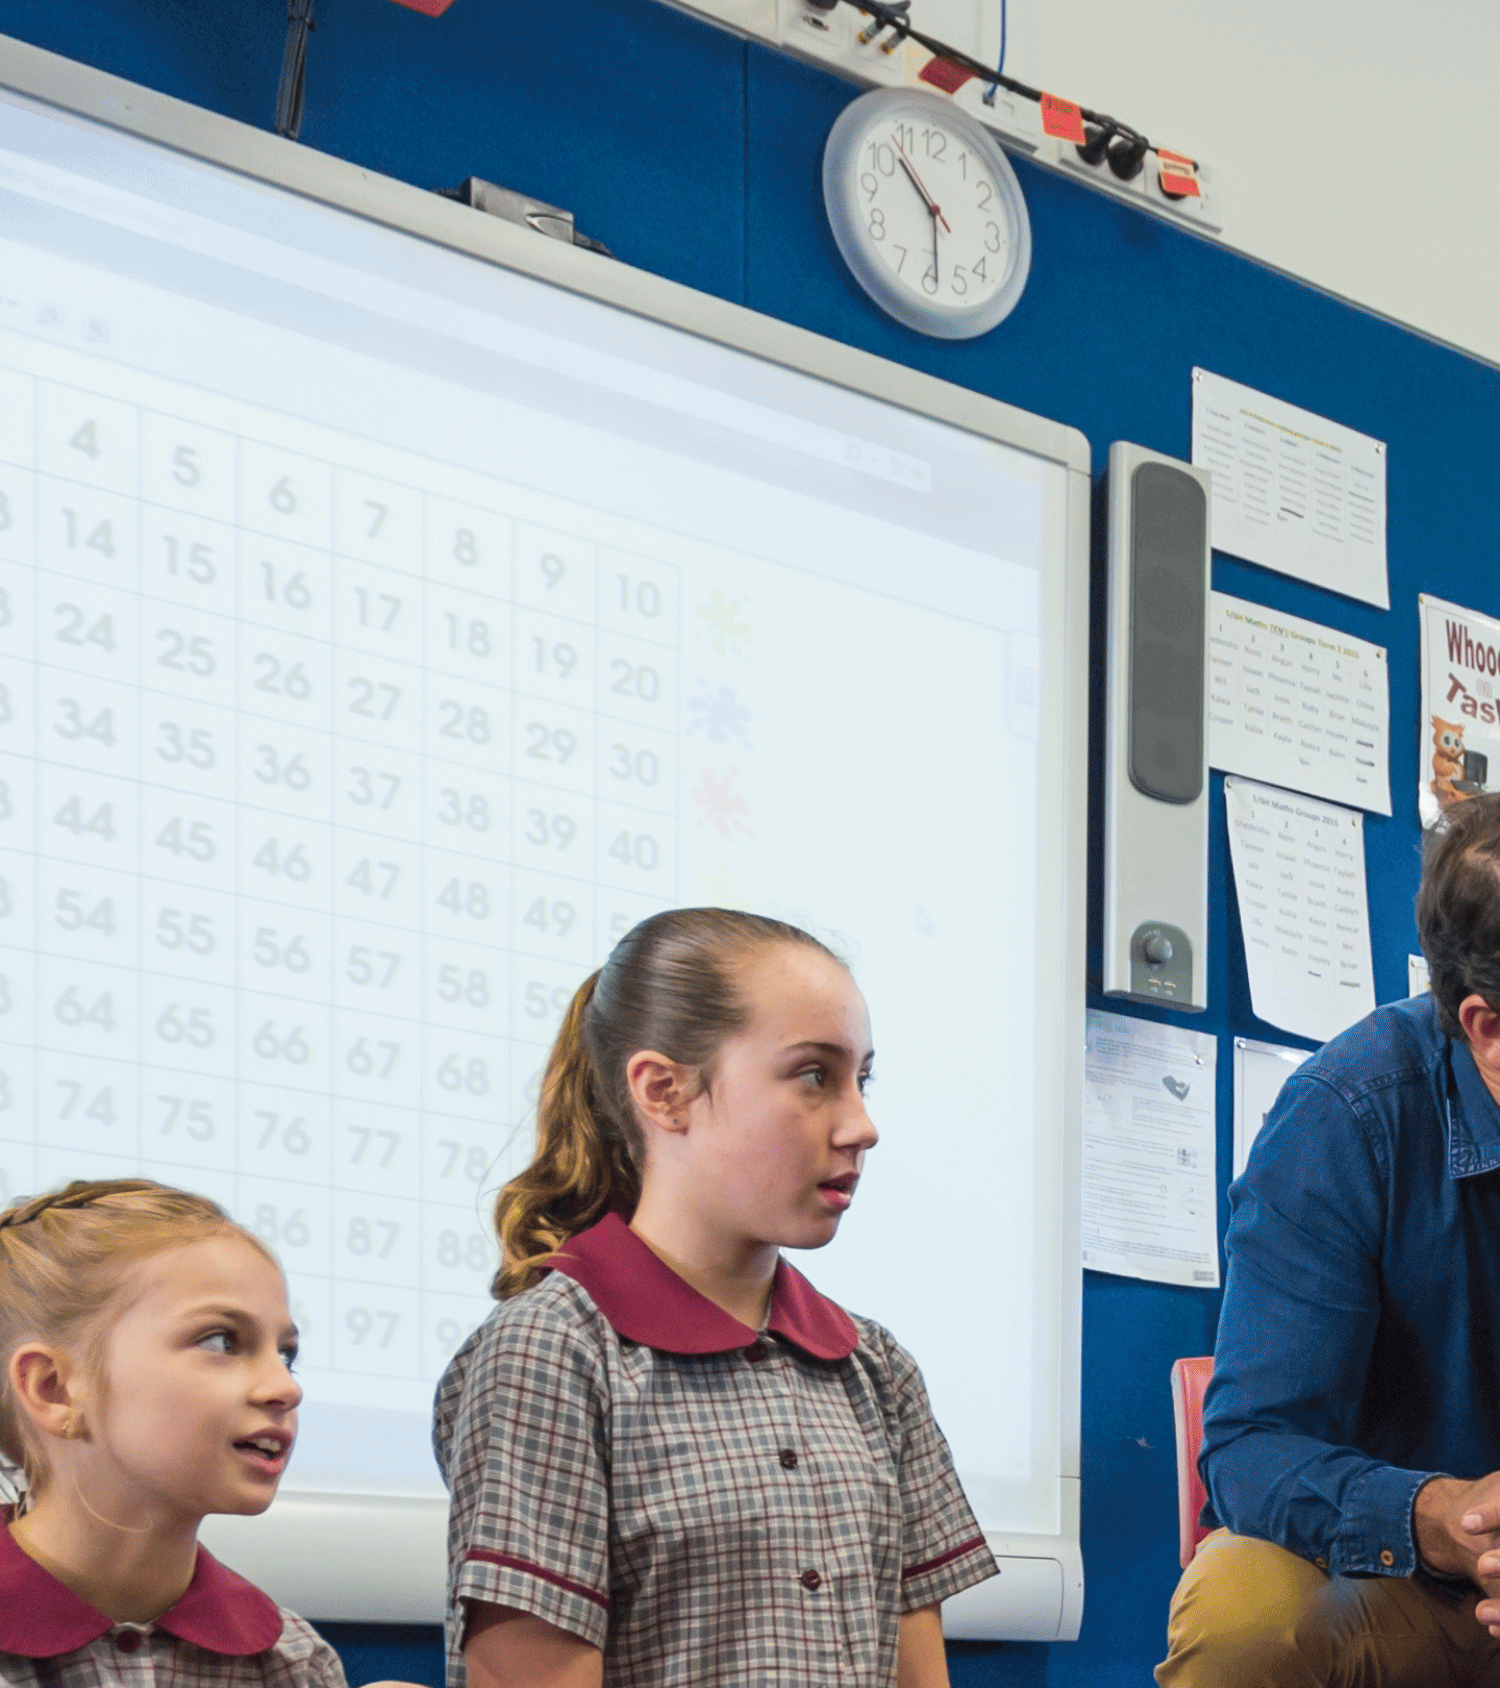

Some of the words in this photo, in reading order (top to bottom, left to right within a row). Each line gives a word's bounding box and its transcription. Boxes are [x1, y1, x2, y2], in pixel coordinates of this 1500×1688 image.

[895, 123, 915, 155] 11
[921, 129, 948, 162] 12
[869, 143, 897, 177] 10
[957, 153, 968, 181] 1
[861, 172, 879, 201] 9
[976, 181, 995, 212] 2
[868, 208, 886, 241] 8
[984, 222, 1001, 254] 3
[892, 245, 908, 274] 7
[971, 256, 988, 284] 4
[921, 263, 938, 295] 6
[951, 266, 967, 296] 5
[68, 418, 102, 461] 4
[171, 444, 203, 489] 5
[268, 475, 300, 516] 6
[363, 498, 391, 540] 7
[452, 527, 481, 568] 8
[538, 552, 568, 591] 9
[615, 572, 663, 620] 10
[60, 506, 118, 560] 14
[161, 533, 218, 586] 15
[259, 560, 313, 611] 16
[353, 585, 404, 633] 17
[443, 610, 493, 660] 18
[531, 634, 580, 680] 19
[609, 656, 661, 704] 20
[53, 601, 119, 655] 24
[155, 626, 218, 679] 25
[253, 651, 314, 702] 26
[347, 675, 404, 722] 27
[437, 698, 493, 747] 28
[525, 720, 579, 766] 29
[608, 741, 661, 788] 30
[53, 696, 119, 749] 34
[154, 720, 218, 771] 35
[252, 742, 313, 793] 36
[346, 765, 404, 812] 37
[436, 786, 493, 834] 38
[523, 806, 578, 852] 39
[607, 828, 661, 873] 40
[52, 793, 120, 844] 44
[153, 815, 219, 864] 45
[251, 836, 313, 883] 46
[345, 857, 403, 901] 47
[435, 876, 493, 922] 48
[522, 895, 578, 938] 49
[53, 887, 118, 937] 54
[155, 906, 217, 957] 55
[252, 925, 313, 975] 56
[346, 944, 403, 990] 57
[437, 962, 492, 1010] 58
[53, 984, 118, 1033] 64
[155, 1002, 217, 1050] 65
[251, 1019, 312, 1066] 66
[345, 1036, 402, 1080] 67
[435, 1052, 492, 1098] 68
[56, 1078, 118, 1127] 74
[156, 1093, 216, 1143] 75
[254, 1108, 313, 1157] 76
[347, 1123, 402, 1169] 77
[438, 1139, 490, 1185] 78
[252, 1201, 312, 1250] 86
[345, 1216, 402, 1260] 87
[435, 1228, 491, 1274] 88
[344, 1306, 401, 1350] 97
